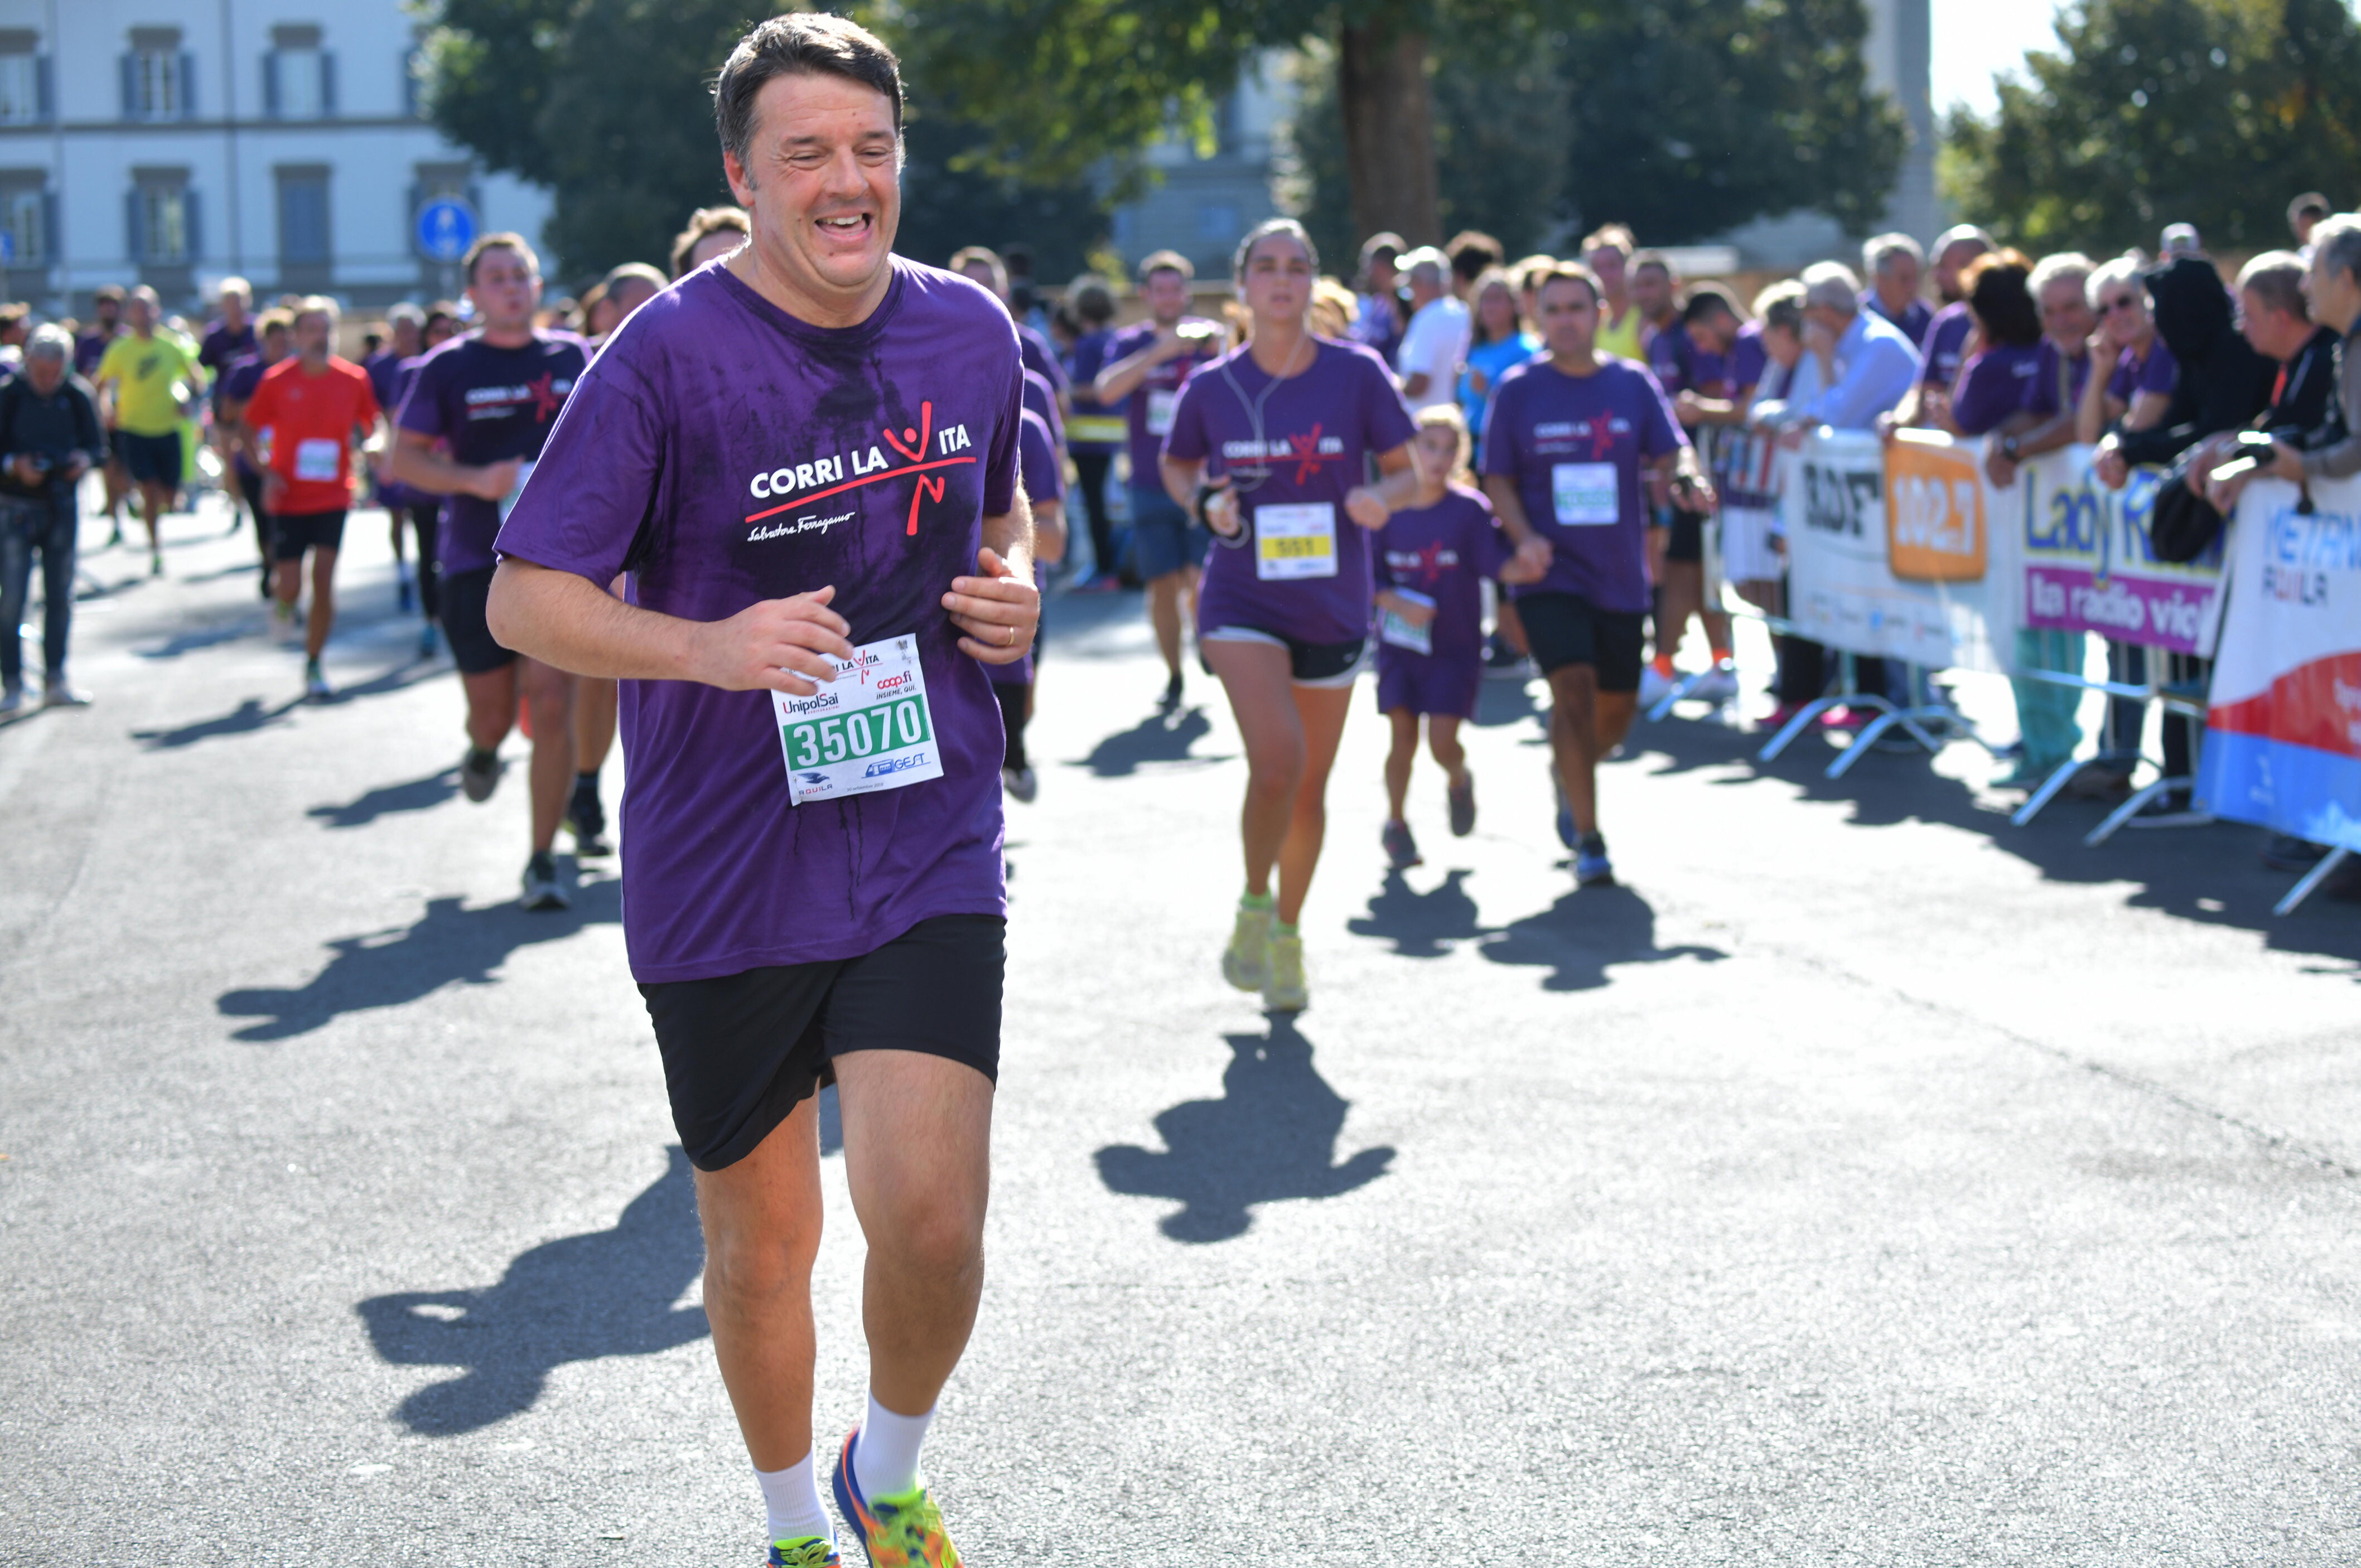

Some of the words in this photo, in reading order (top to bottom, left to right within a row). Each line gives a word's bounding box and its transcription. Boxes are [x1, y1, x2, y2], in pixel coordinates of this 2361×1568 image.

[1269, 439, 1292, 457] LA
[750, 454, 843, 499] CORRI
[851, 446, 889, 476] LA
[1893, 471, 1977, 557] 102.7
[747, 522, 798, 542] Salvatore
[797, 511, 856, 535] Ferragamo
[2031, 572, 2066, 618] la
[2070, 580, 2146, 632] radio
[842, 661, 854, 670] LA
[877, 670, 912, 689] coop.fi
[783, 692, 839, 714] UnipolSai
[876, 688, 902, 700] INSIEME,
[793, 700, 921, 767] 35070
[799, 783, 833, 795] AQUILA
